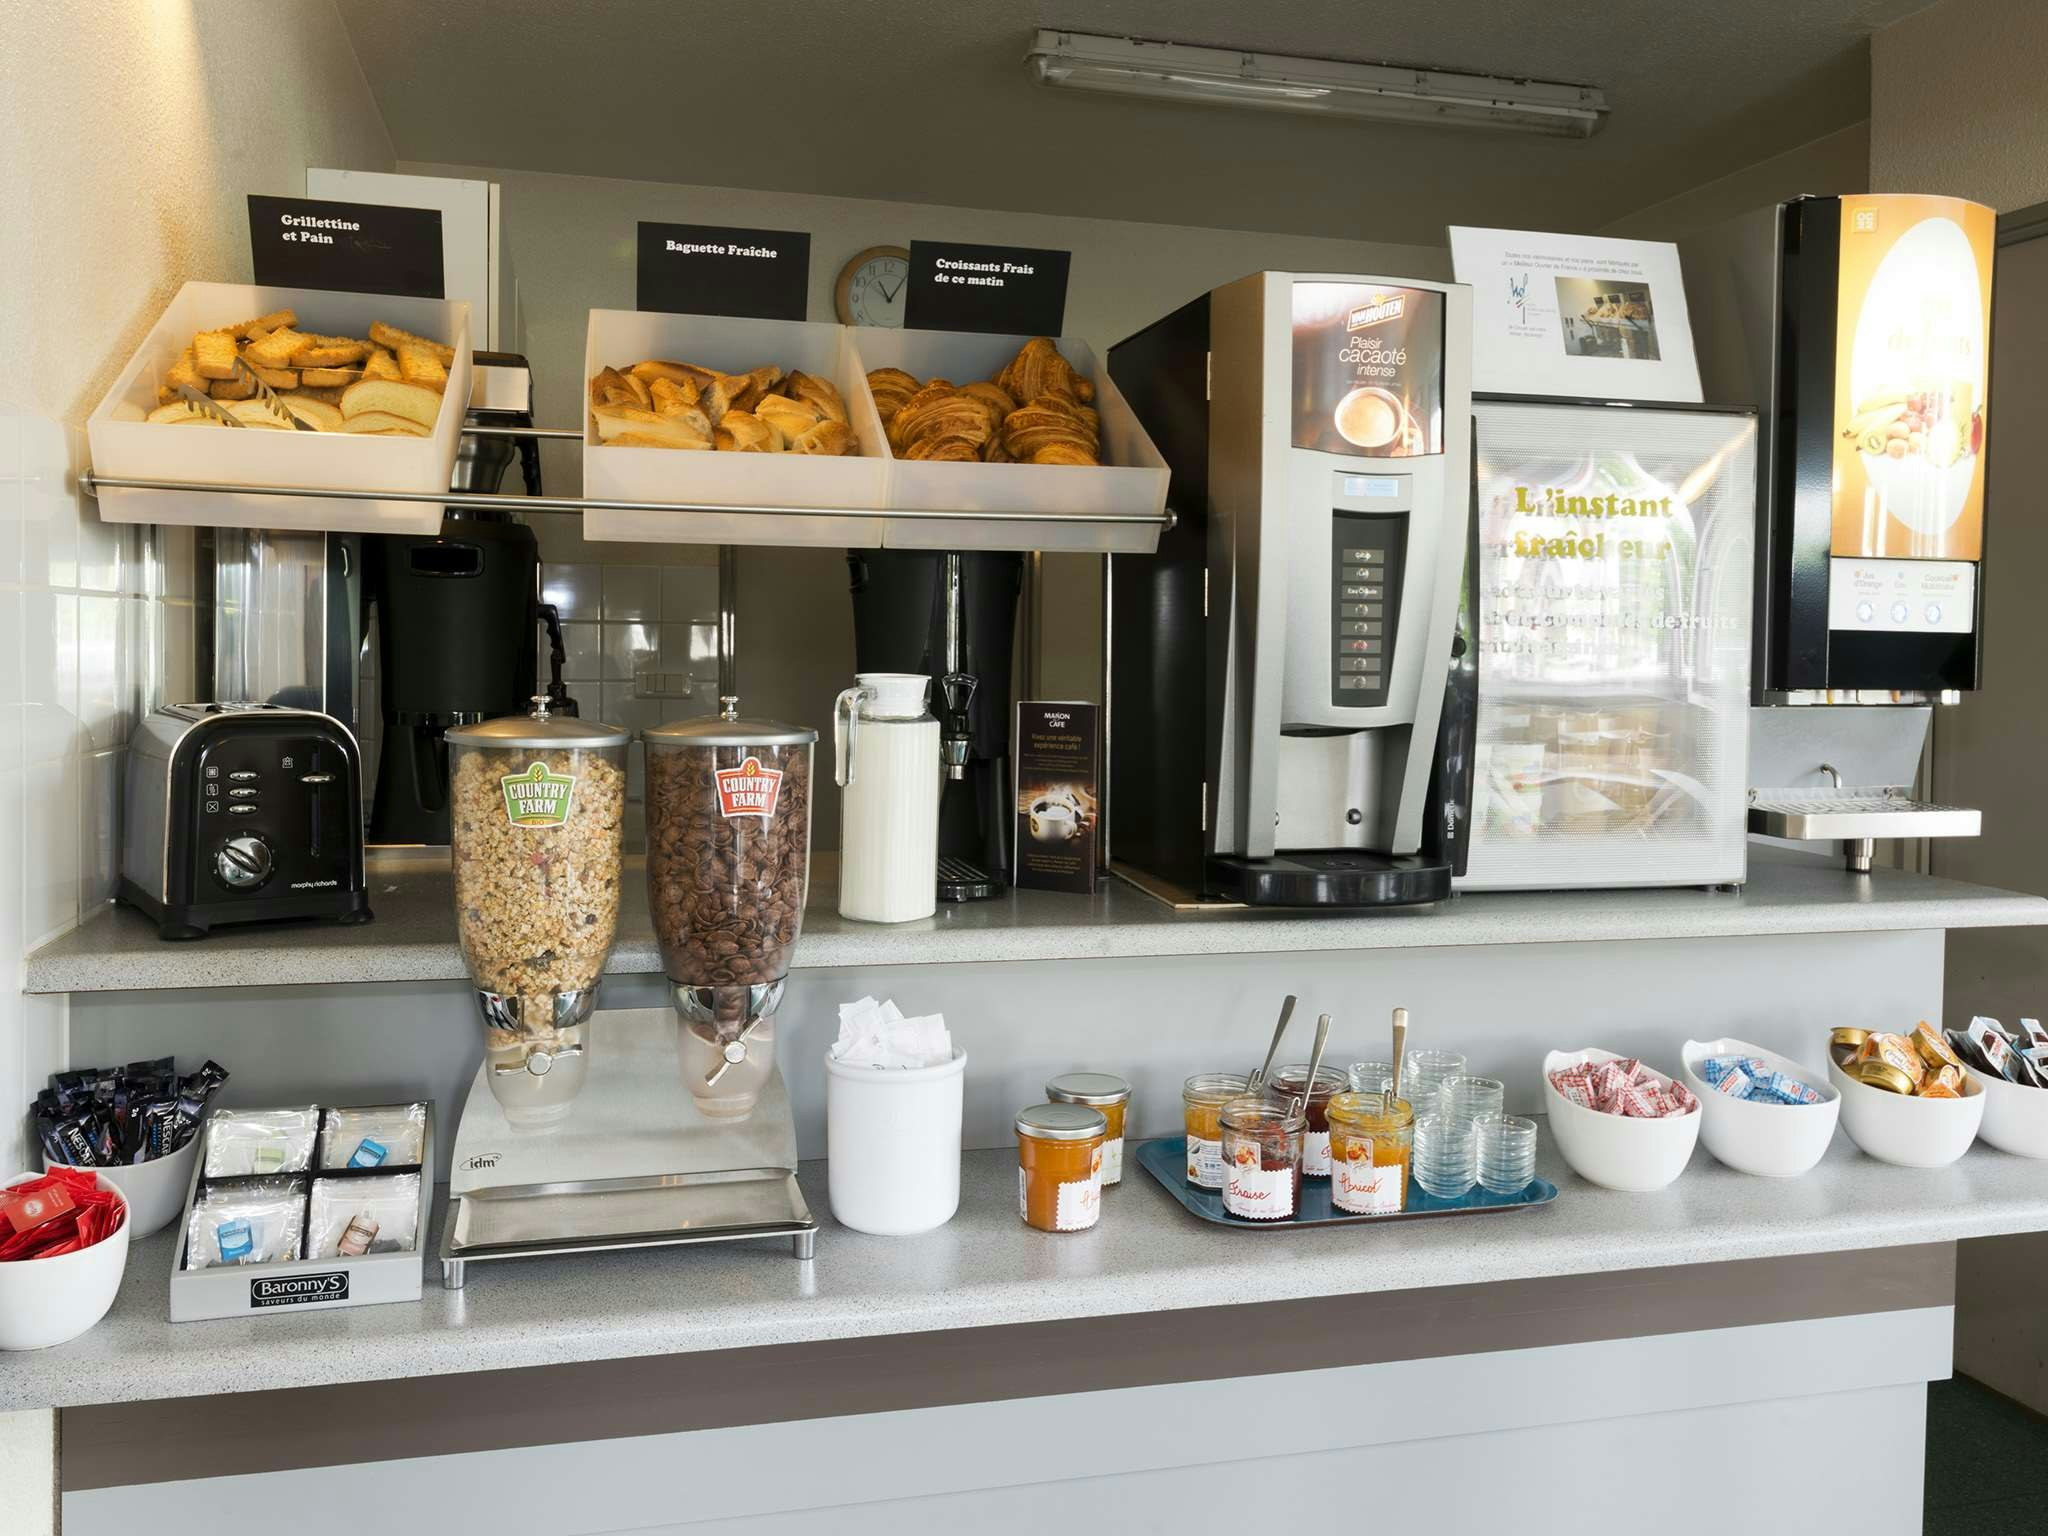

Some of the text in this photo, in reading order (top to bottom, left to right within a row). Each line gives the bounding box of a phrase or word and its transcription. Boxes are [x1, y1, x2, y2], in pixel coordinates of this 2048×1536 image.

[281, 214, 360, 231] Grillettine
[282, 231, 333, 244] et Pain
[666, 240, 777, 258] Baguette Fraîche
[936, 258, 1034, 275] Croissants Frais
[934, 273, 1004, 287] de ce matin
[1350, 336, 1383, 350] Plaisir
[1339, 348, 1407, 365] cacaoté
[1357, 364, 1396, 378] intense
[1514, 485, 1673, 519] L'instant
[508, 782, 568, 800] COUNTRY
[722, 777, 777, 793] COUNTRY
[519, 799, 557, 815] FARM
[732, 793, 768, 808] FARM
[291, 879, 338, 889] morphy richards
[162, 1114, 174, 1156] NESCAF
[470, 1157, 495, 1169] idm
[1229, 1179, 1272, 1201] Fraise
[261, 1297, 294, 1306] saveurs
[311, 1292, 341, 1301] monde
